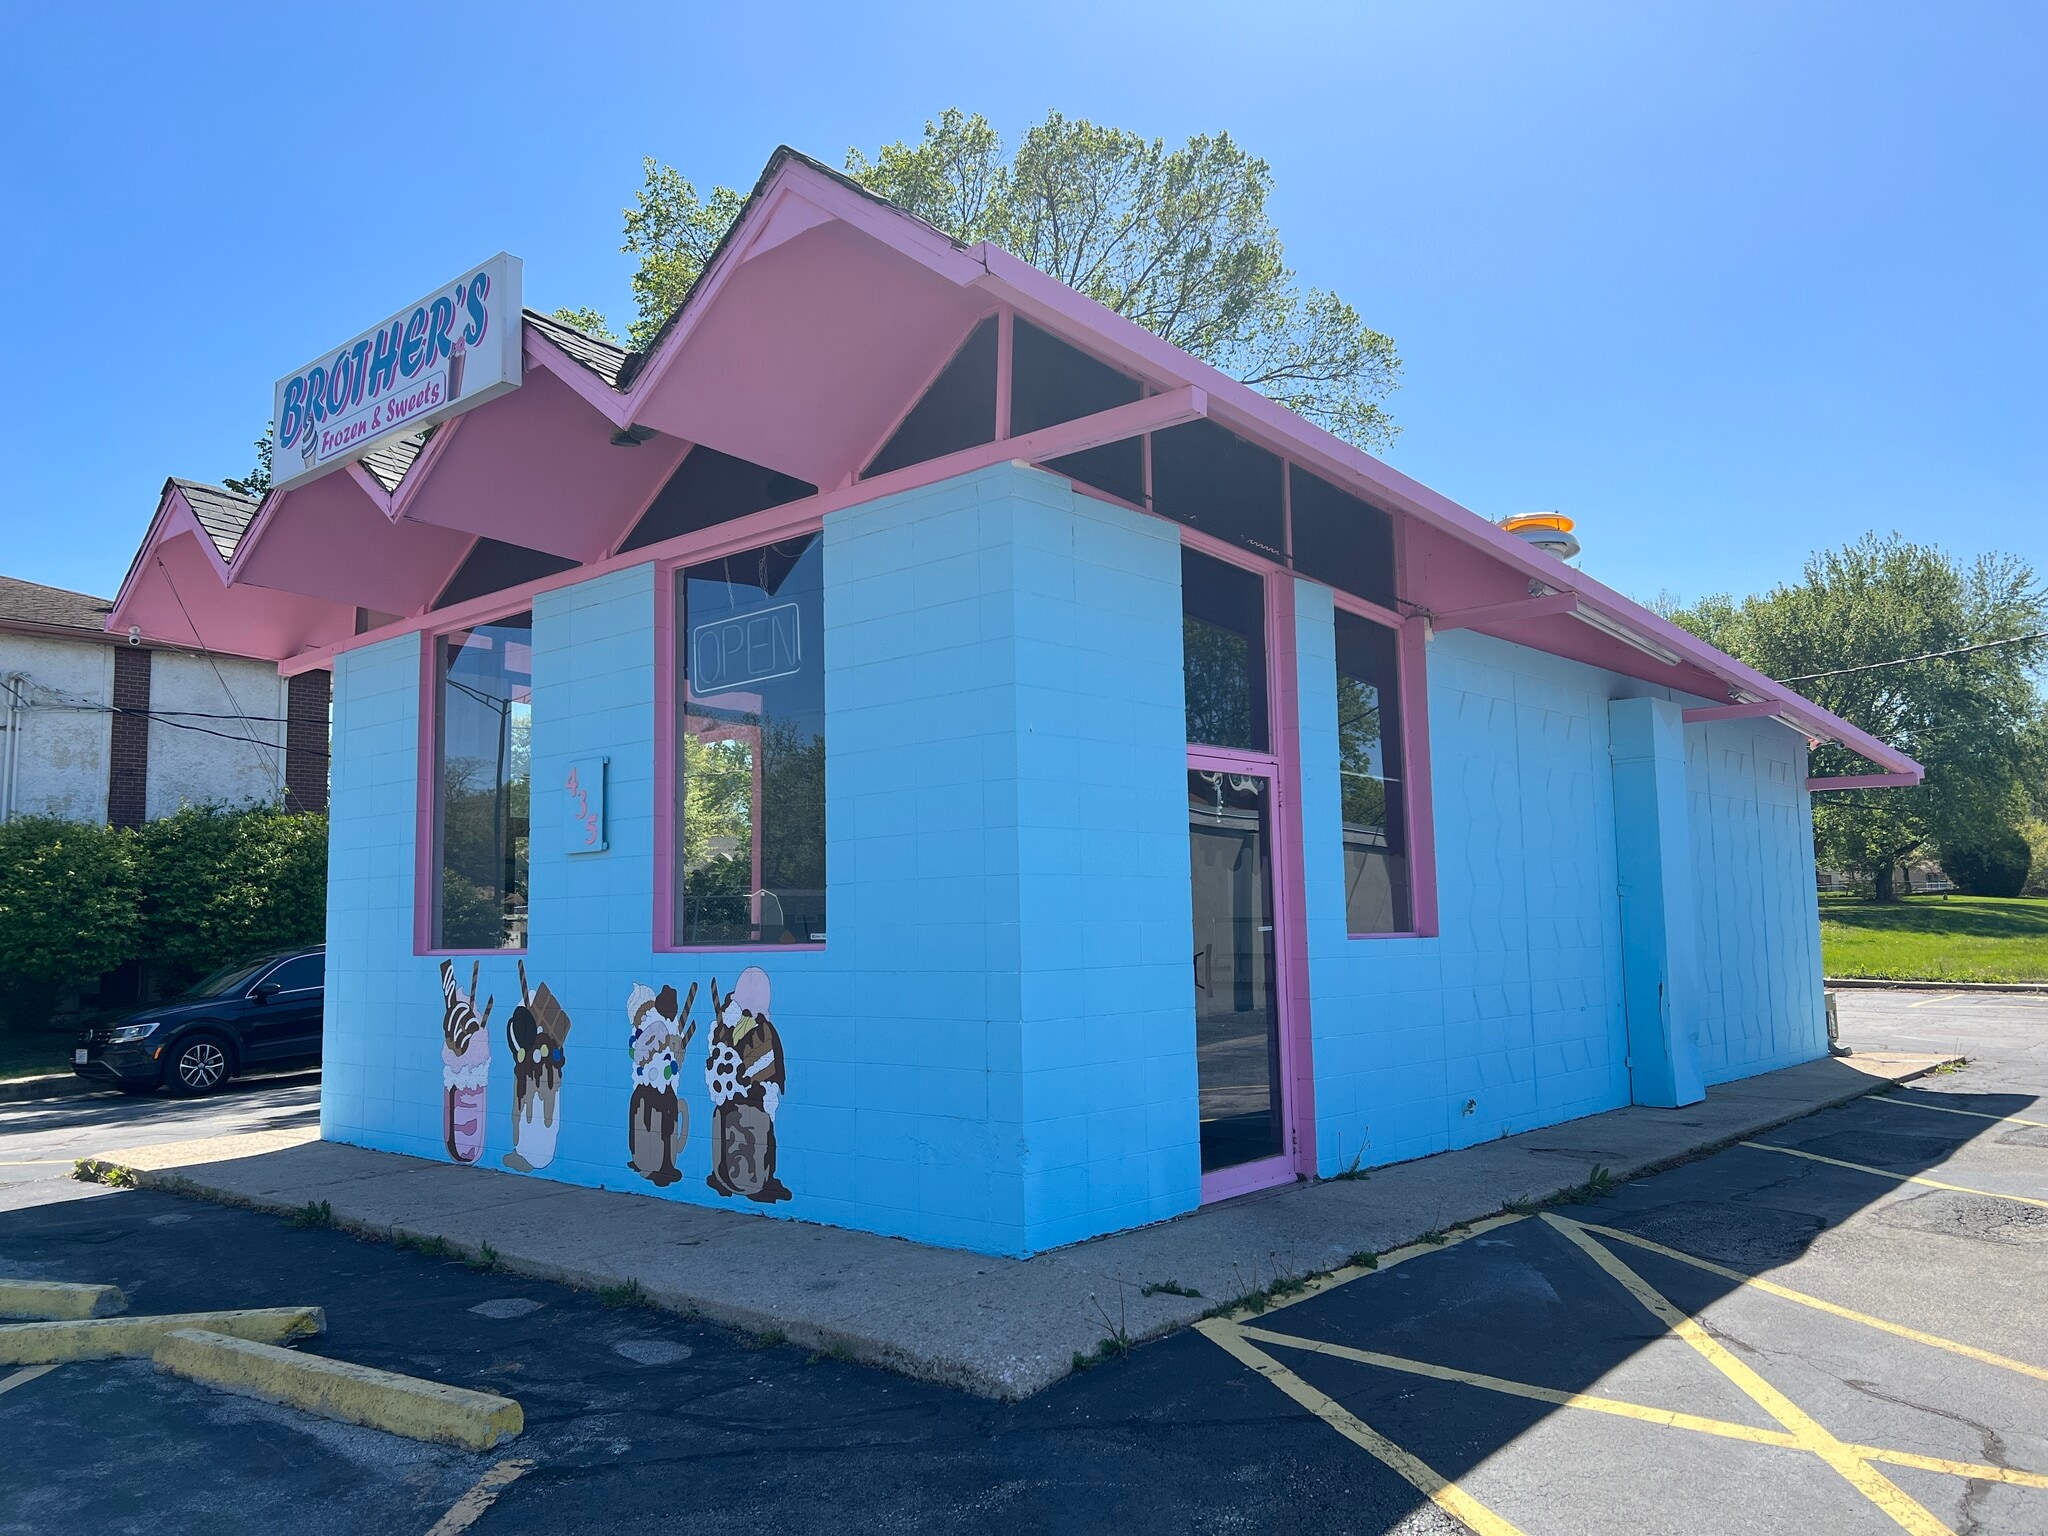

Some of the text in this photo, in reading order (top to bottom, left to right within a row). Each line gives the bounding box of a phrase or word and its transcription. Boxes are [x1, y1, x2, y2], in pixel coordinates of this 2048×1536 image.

[280, 272, 491, 449] BROTHER'S
[321, 380, 439, 454] Frozen & Sweets
[698, 614, 795, 684] OPEN
[565, 767, 598, 845] 435
